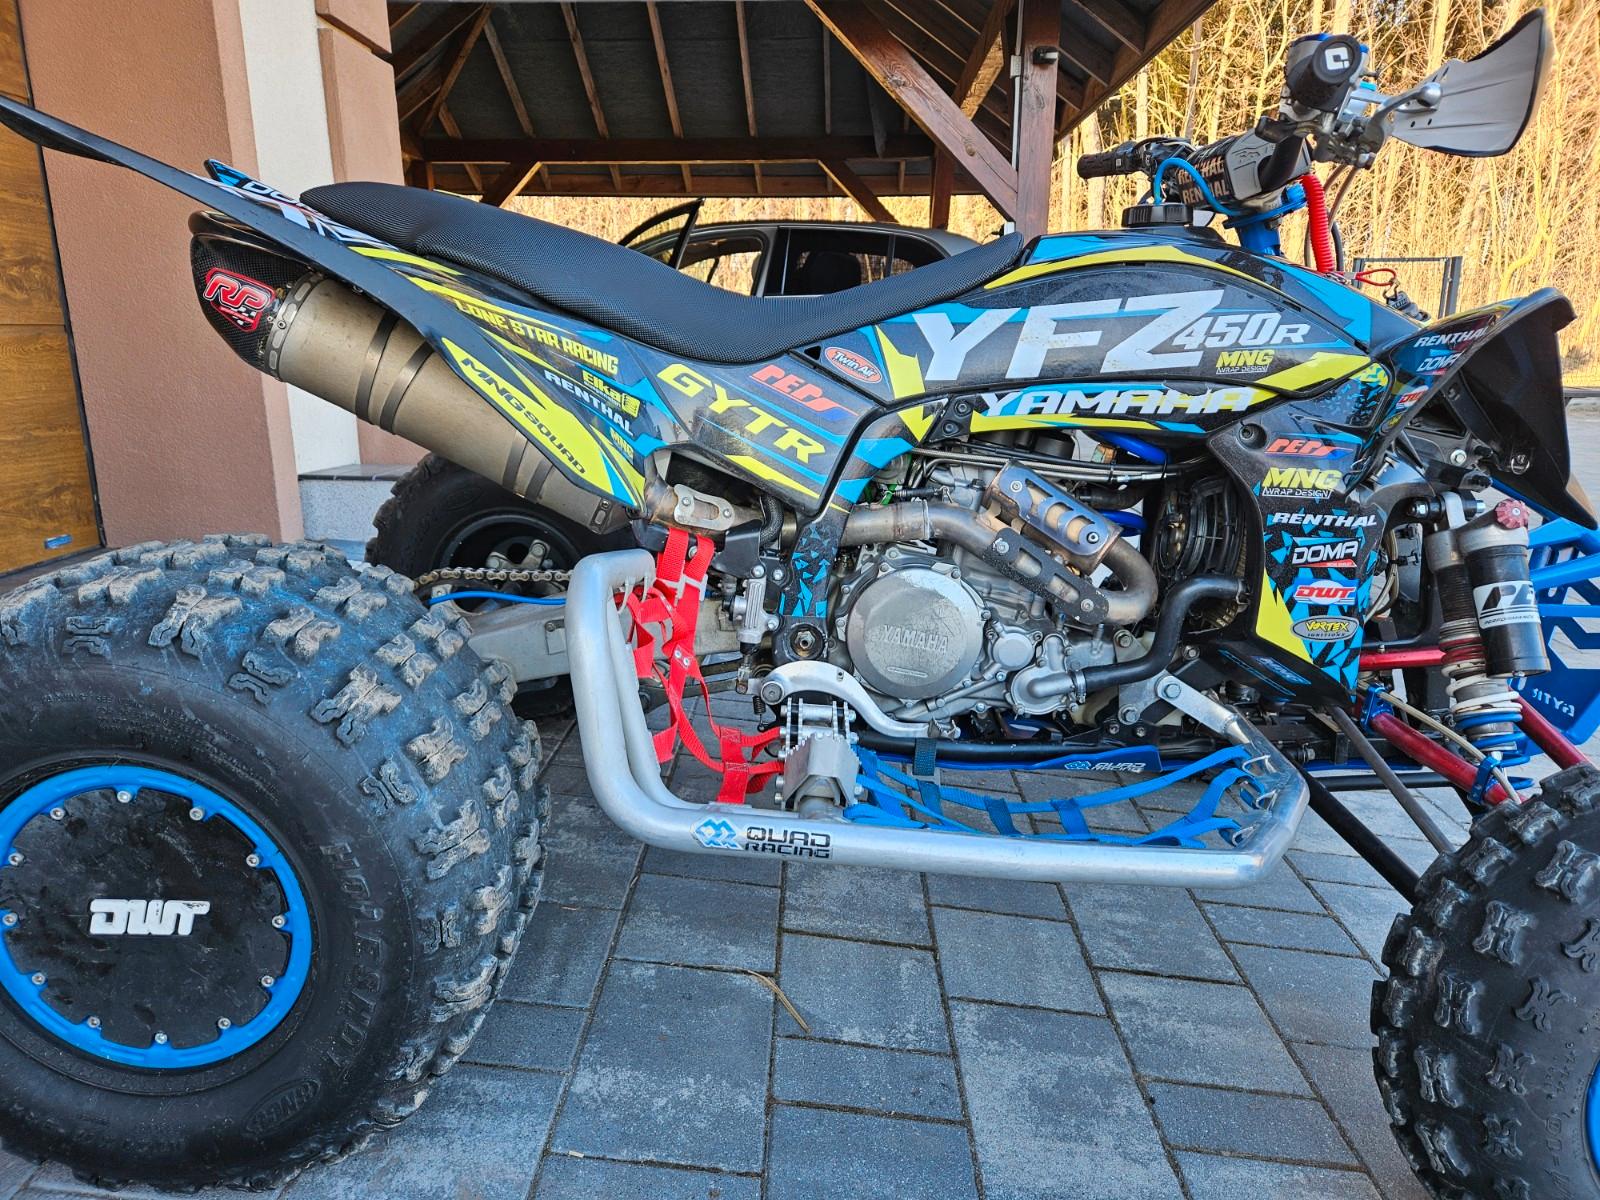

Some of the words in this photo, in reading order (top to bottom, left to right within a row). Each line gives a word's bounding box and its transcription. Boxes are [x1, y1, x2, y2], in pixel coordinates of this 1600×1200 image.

[1182, 180, 1230, 204] RENAL
[456, 300, 511, 330] LONE
[509, 319, 560, 349] STAR
[562, 335, 619, 376] RACING
[913, 290, 1224, 381] YFZ
[833, 351, 858, 370] Twin
[859, 365, 876, 377] Air
[1216, 350, 1275, 367] MNG
[544, 370, 634, 436] RENTHAL
[656, 363, 826, 465] GYTR
[981, 387, 1257, 417] YAMAHA
[1262, 467, 1343, 489] MNG
[1295, 489, 1329, 497] DESIGN
[1272, 512, 1377, 529] RENTHAL
[1292, 541, 1358, 564] DOMA
[1295, 586, 1356, 598] DWT
[884, 624, 948, 653] YAMAHA
[746, 826, 831, 848] QUAD
[744, 843, 830, 859] RACING
[90, 899, 211, 936] DWT
